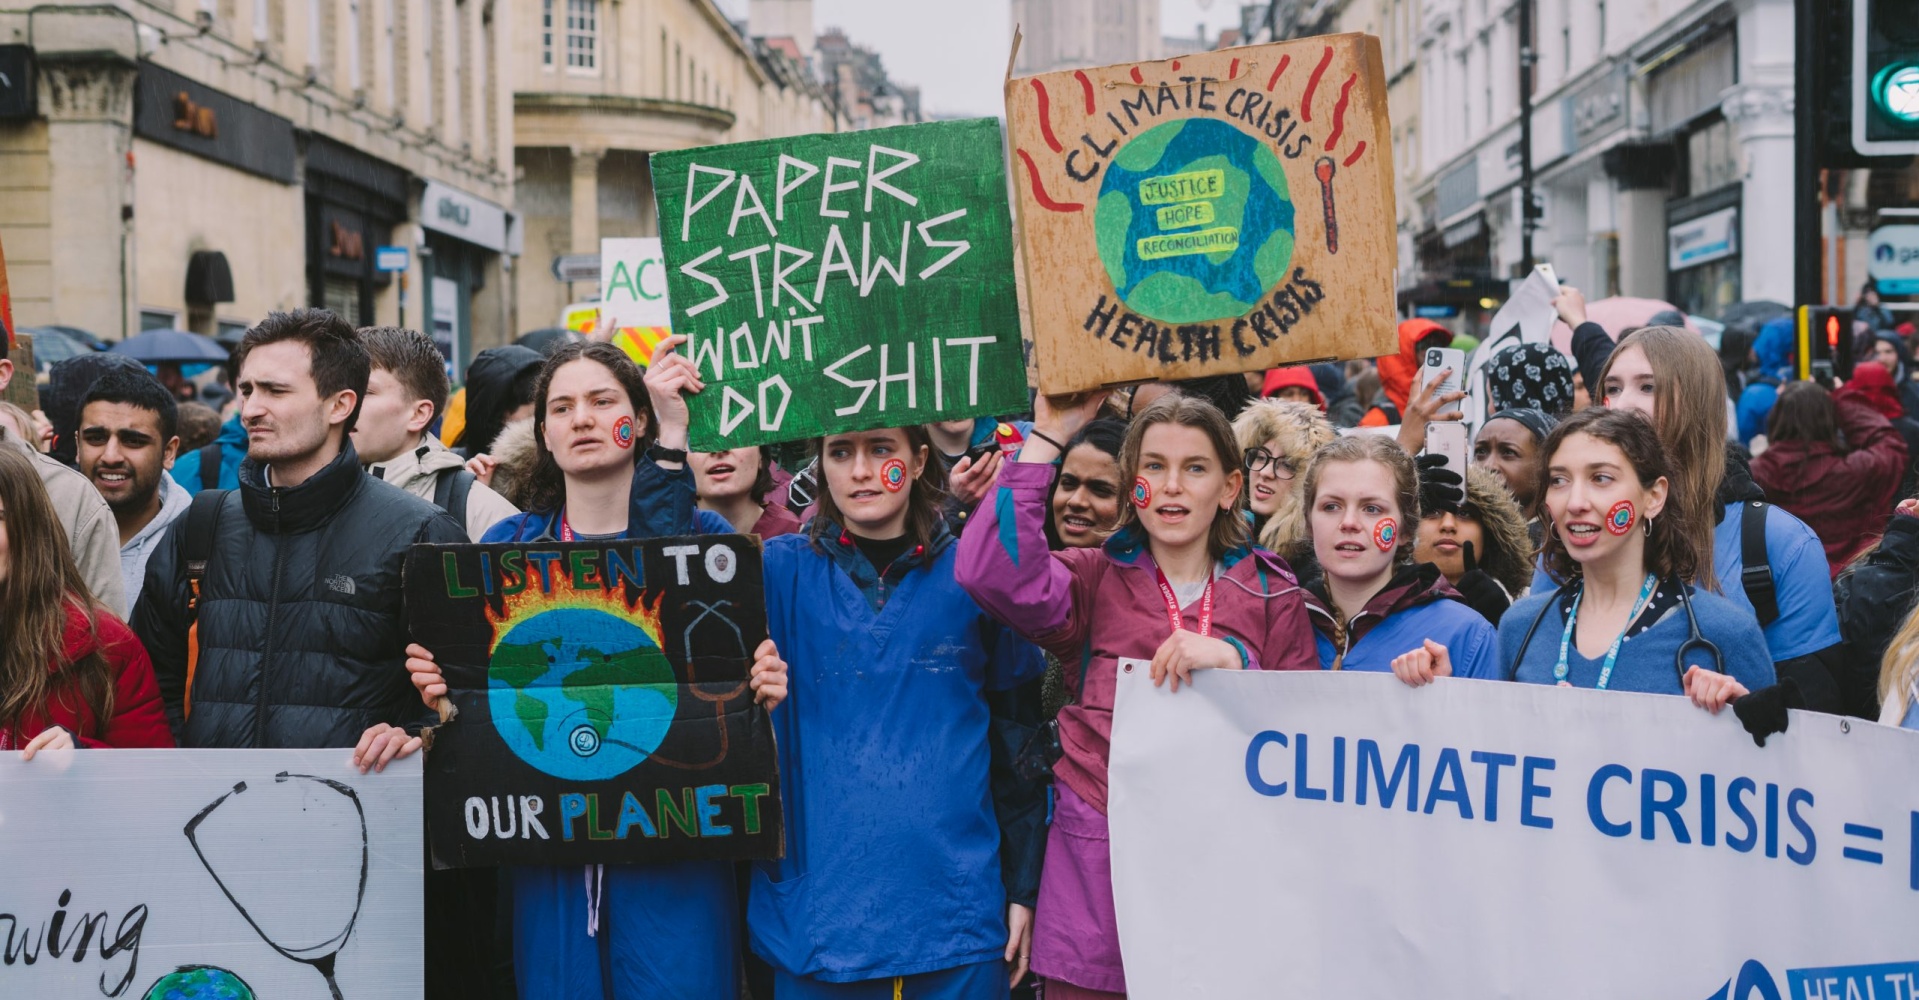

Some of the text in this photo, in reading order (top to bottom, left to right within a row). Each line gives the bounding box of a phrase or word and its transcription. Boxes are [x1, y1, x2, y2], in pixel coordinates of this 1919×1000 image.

[1065, 77, 1312, 183] CLIMATE CRISIS
[682, 144, 920, 241] PAPER
[1145, 176, 1217, 201] JUSTICE
[1165, 205, 1203, 225] HOPE
[680, 208, 971, 318] STRAWS
[1143, 231, 1238, 256] RECONCILIATION
[605, 258, 664, 302] AC
[1083, 267, 1325, 365] HEALTH CRISIS
[719, 374, 792, 437] DO
[823, 336, 997, 417] SHIT
[324, 578, 346, 586] NORTH
[442, 542, 737, 597] LISTEN TO
[1645, 575, 1656, 592] NHS
[1160, 583, 1176, 609] STUDENT
[1608, 640, 1620, 660] NHS
[1598, 667, 1611, 688] NHS
[464, 783, 770, 841] OUR PLANET
[1244, 729, 1556, 829] CLIMATE
[1586, 763, 1817, 866] CRISIS
